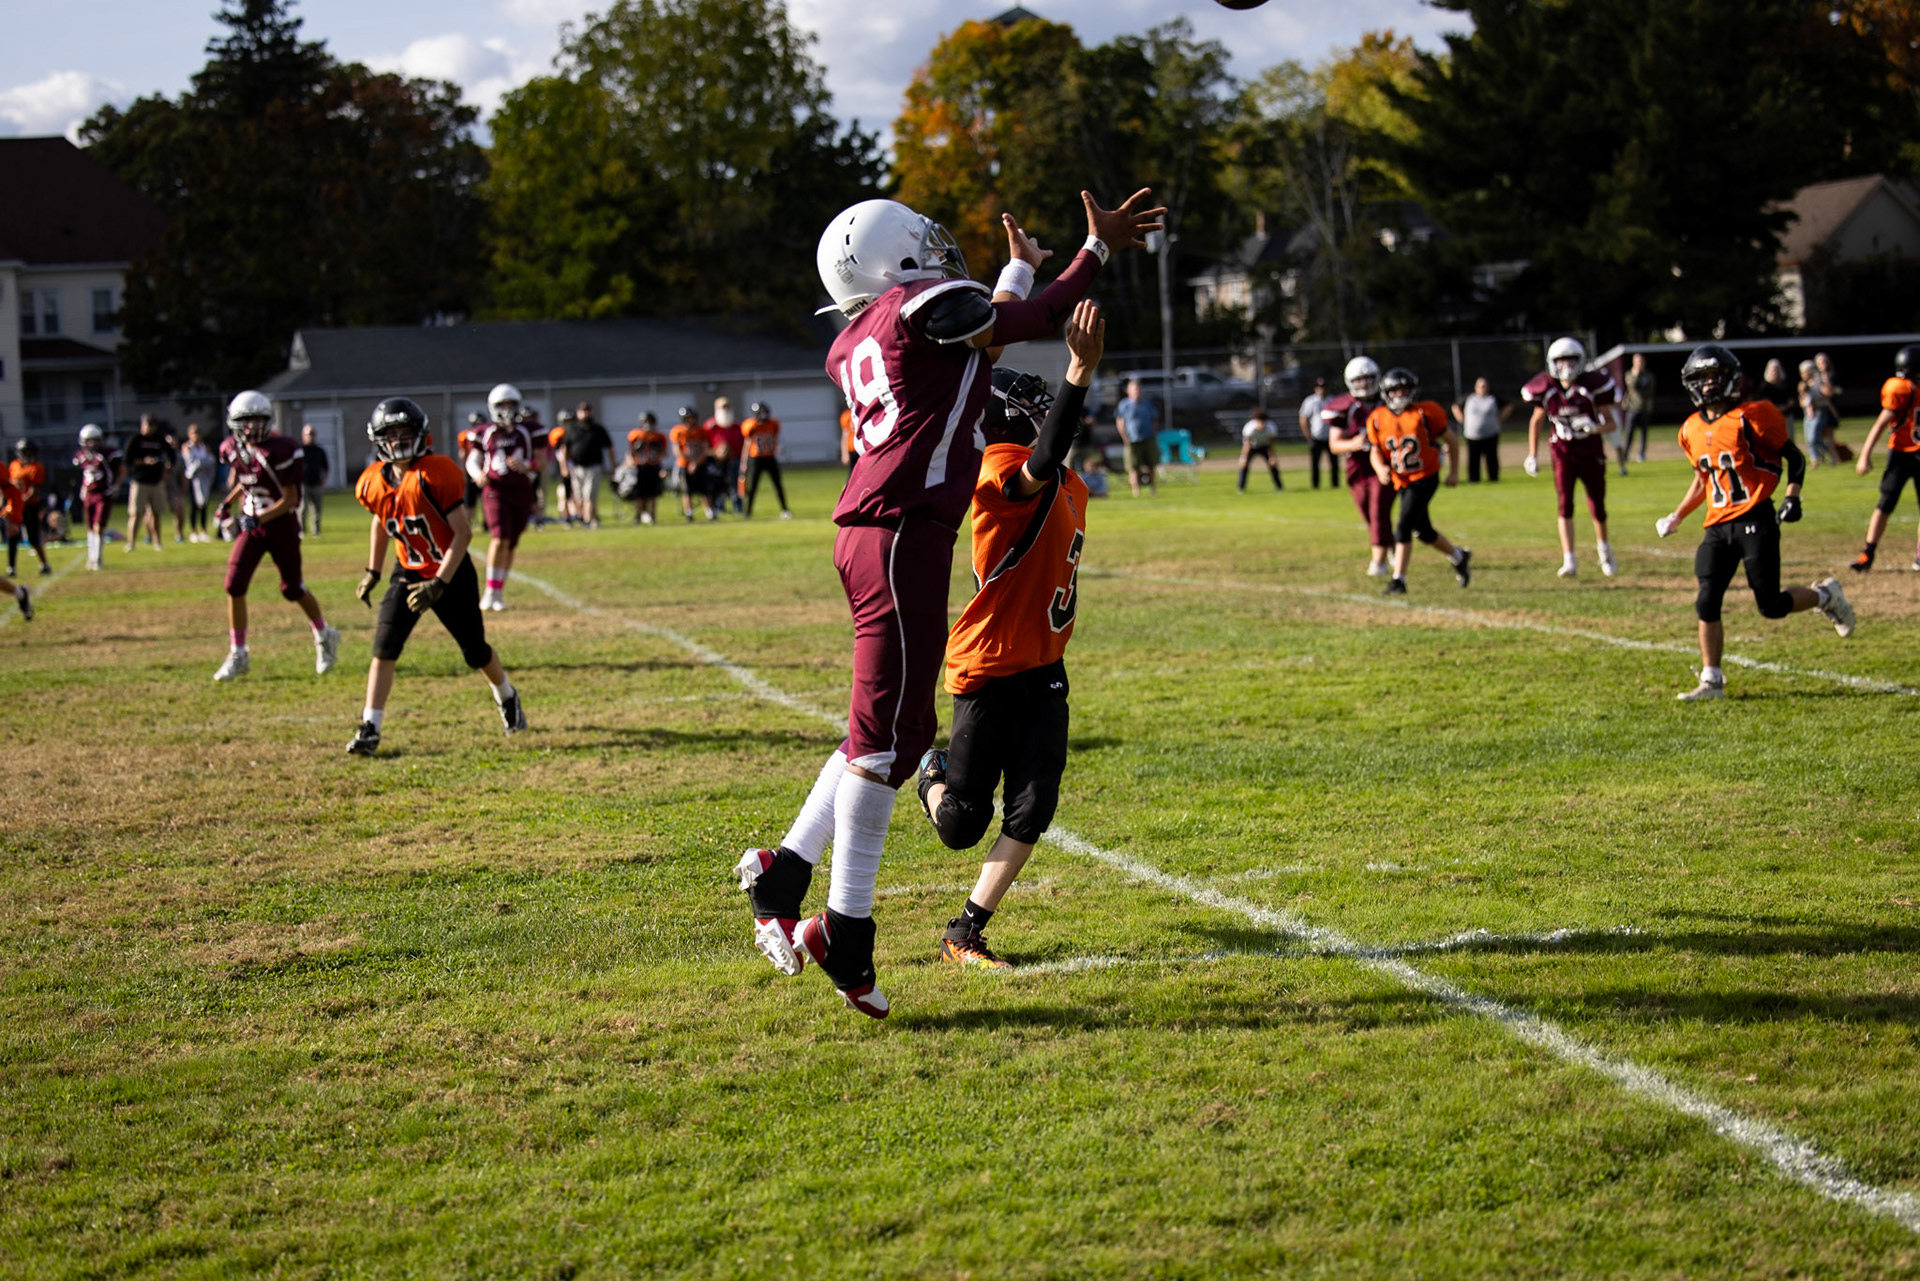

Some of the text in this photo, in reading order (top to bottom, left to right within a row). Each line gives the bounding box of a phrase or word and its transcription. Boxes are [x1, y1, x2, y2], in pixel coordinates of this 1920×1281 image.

[840, 335, 899, 457] 19
[1385, 434, 1423, 474] 12
[1698, 451, 1750, 508] 11
[386, 514, 444, 567] 17
[1048, 528, 1085, 634] 3
